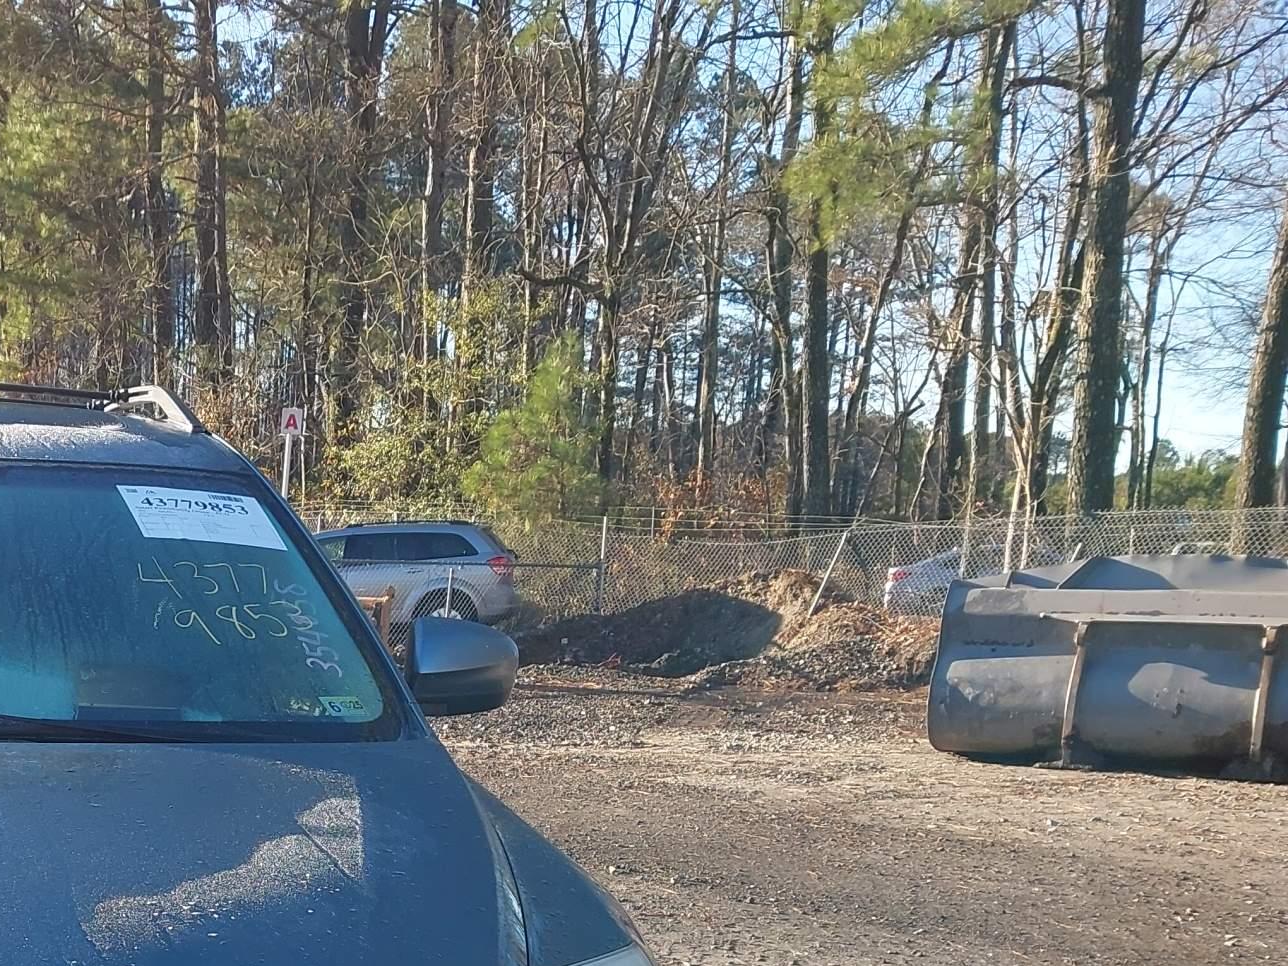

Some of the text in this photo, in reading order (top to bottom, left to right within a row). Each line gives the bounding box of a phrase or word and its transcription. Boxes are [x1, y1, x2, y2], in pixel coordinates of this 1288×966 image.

[285, 413, 299, 430] A
[140, 497, 249, 515] 43779853
[137, 555, 267, 600] 4377
